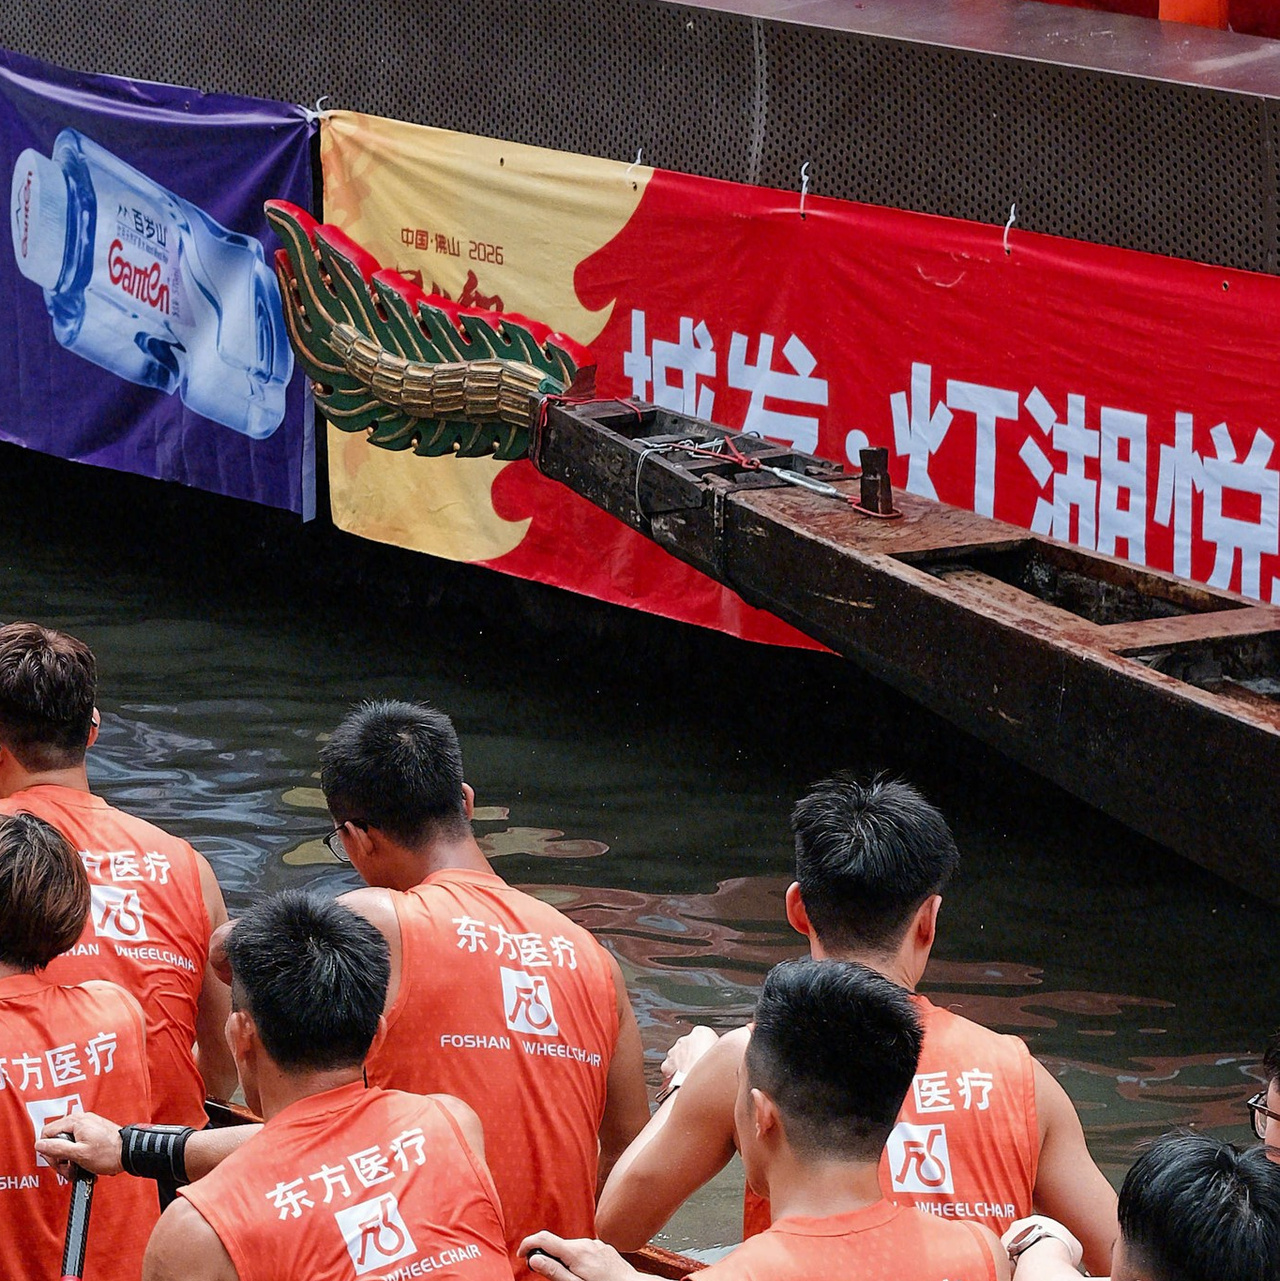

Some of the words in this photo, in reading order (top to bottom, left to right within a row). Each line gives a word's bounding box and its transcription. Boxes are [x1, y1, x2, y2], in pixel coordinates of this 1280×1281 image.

[131, 207, 168, 248] 百岁山
[468, 240, 504, 265] 2026
[108, 238, 170, 315] Ganten
[78, 850, 171, 885] 方医疗
[114, 944, 198, 973] WHEELCHAIR
[452, 915, 578, 970] 东方医疗
[441, 1034, 511, 1051] FOSHAN
[912, 1067, 994, 1114] 医疗
[265, 1127, 427, 1221] 东方医疗
[914, 1200, 1016, 1218] WHEELCHAIR
